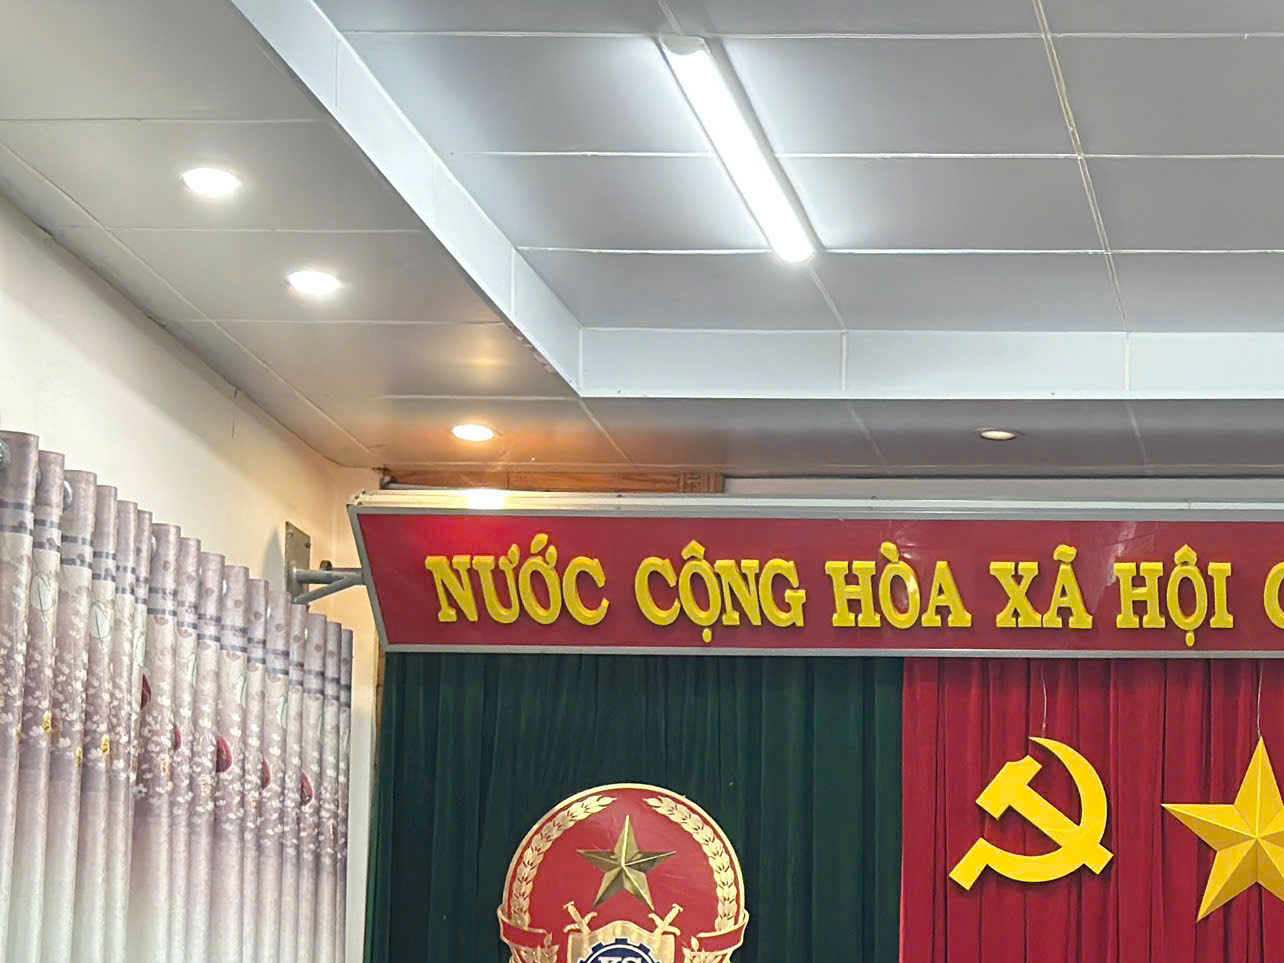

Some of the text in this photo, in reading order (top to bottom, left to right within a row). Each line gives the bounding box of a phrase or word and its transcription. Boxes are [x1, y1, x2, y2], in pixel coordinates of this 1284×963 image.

[425, 533, 610, 625] NƯỚC
[635, 540, 807, 643] CỘNG
[825, 541, 973, 628] HÒA
[990, 544, 1094, 629] XÃ
[1116, 544, 1236, 646] HỘI
